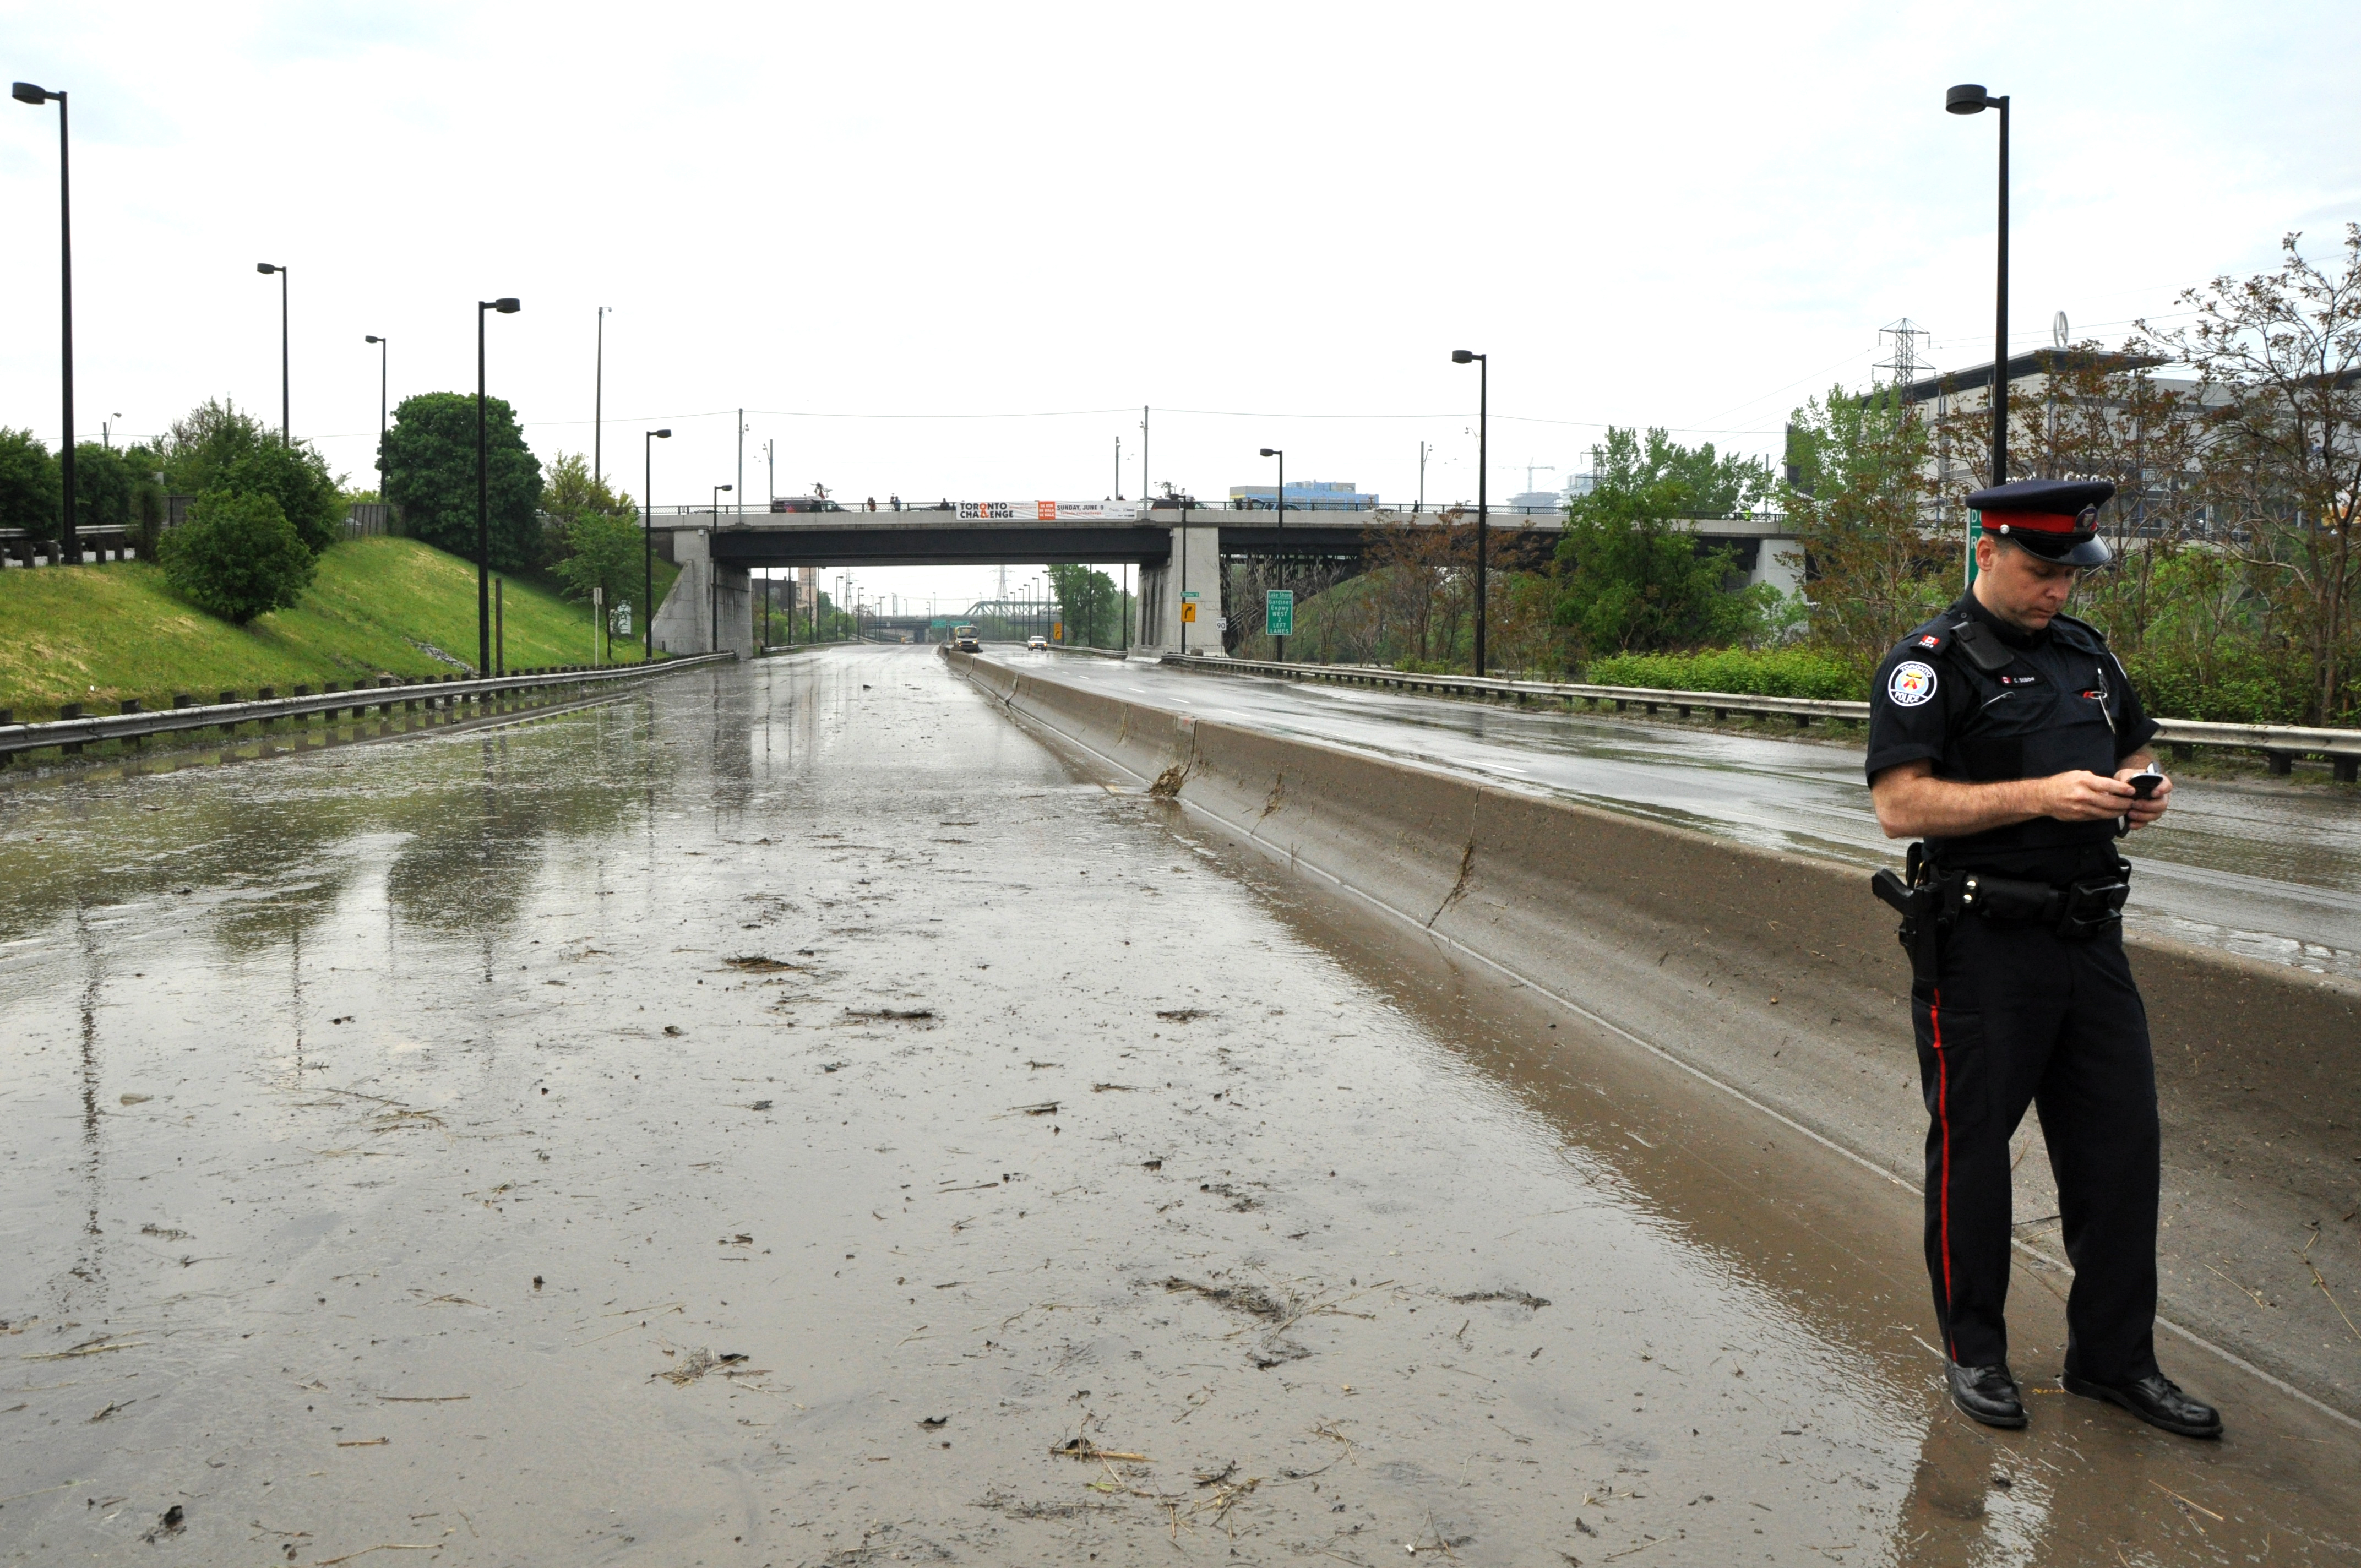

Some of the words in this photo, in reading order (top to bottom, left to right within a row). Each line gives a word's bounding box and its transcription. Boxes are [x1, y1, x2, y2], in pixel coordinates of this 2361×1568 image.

[960, 502, 1007, 510] TORONTO
[1900, 664, 1932, 678] TORONTO
[1895, 692, 1920, 703] POLICE
